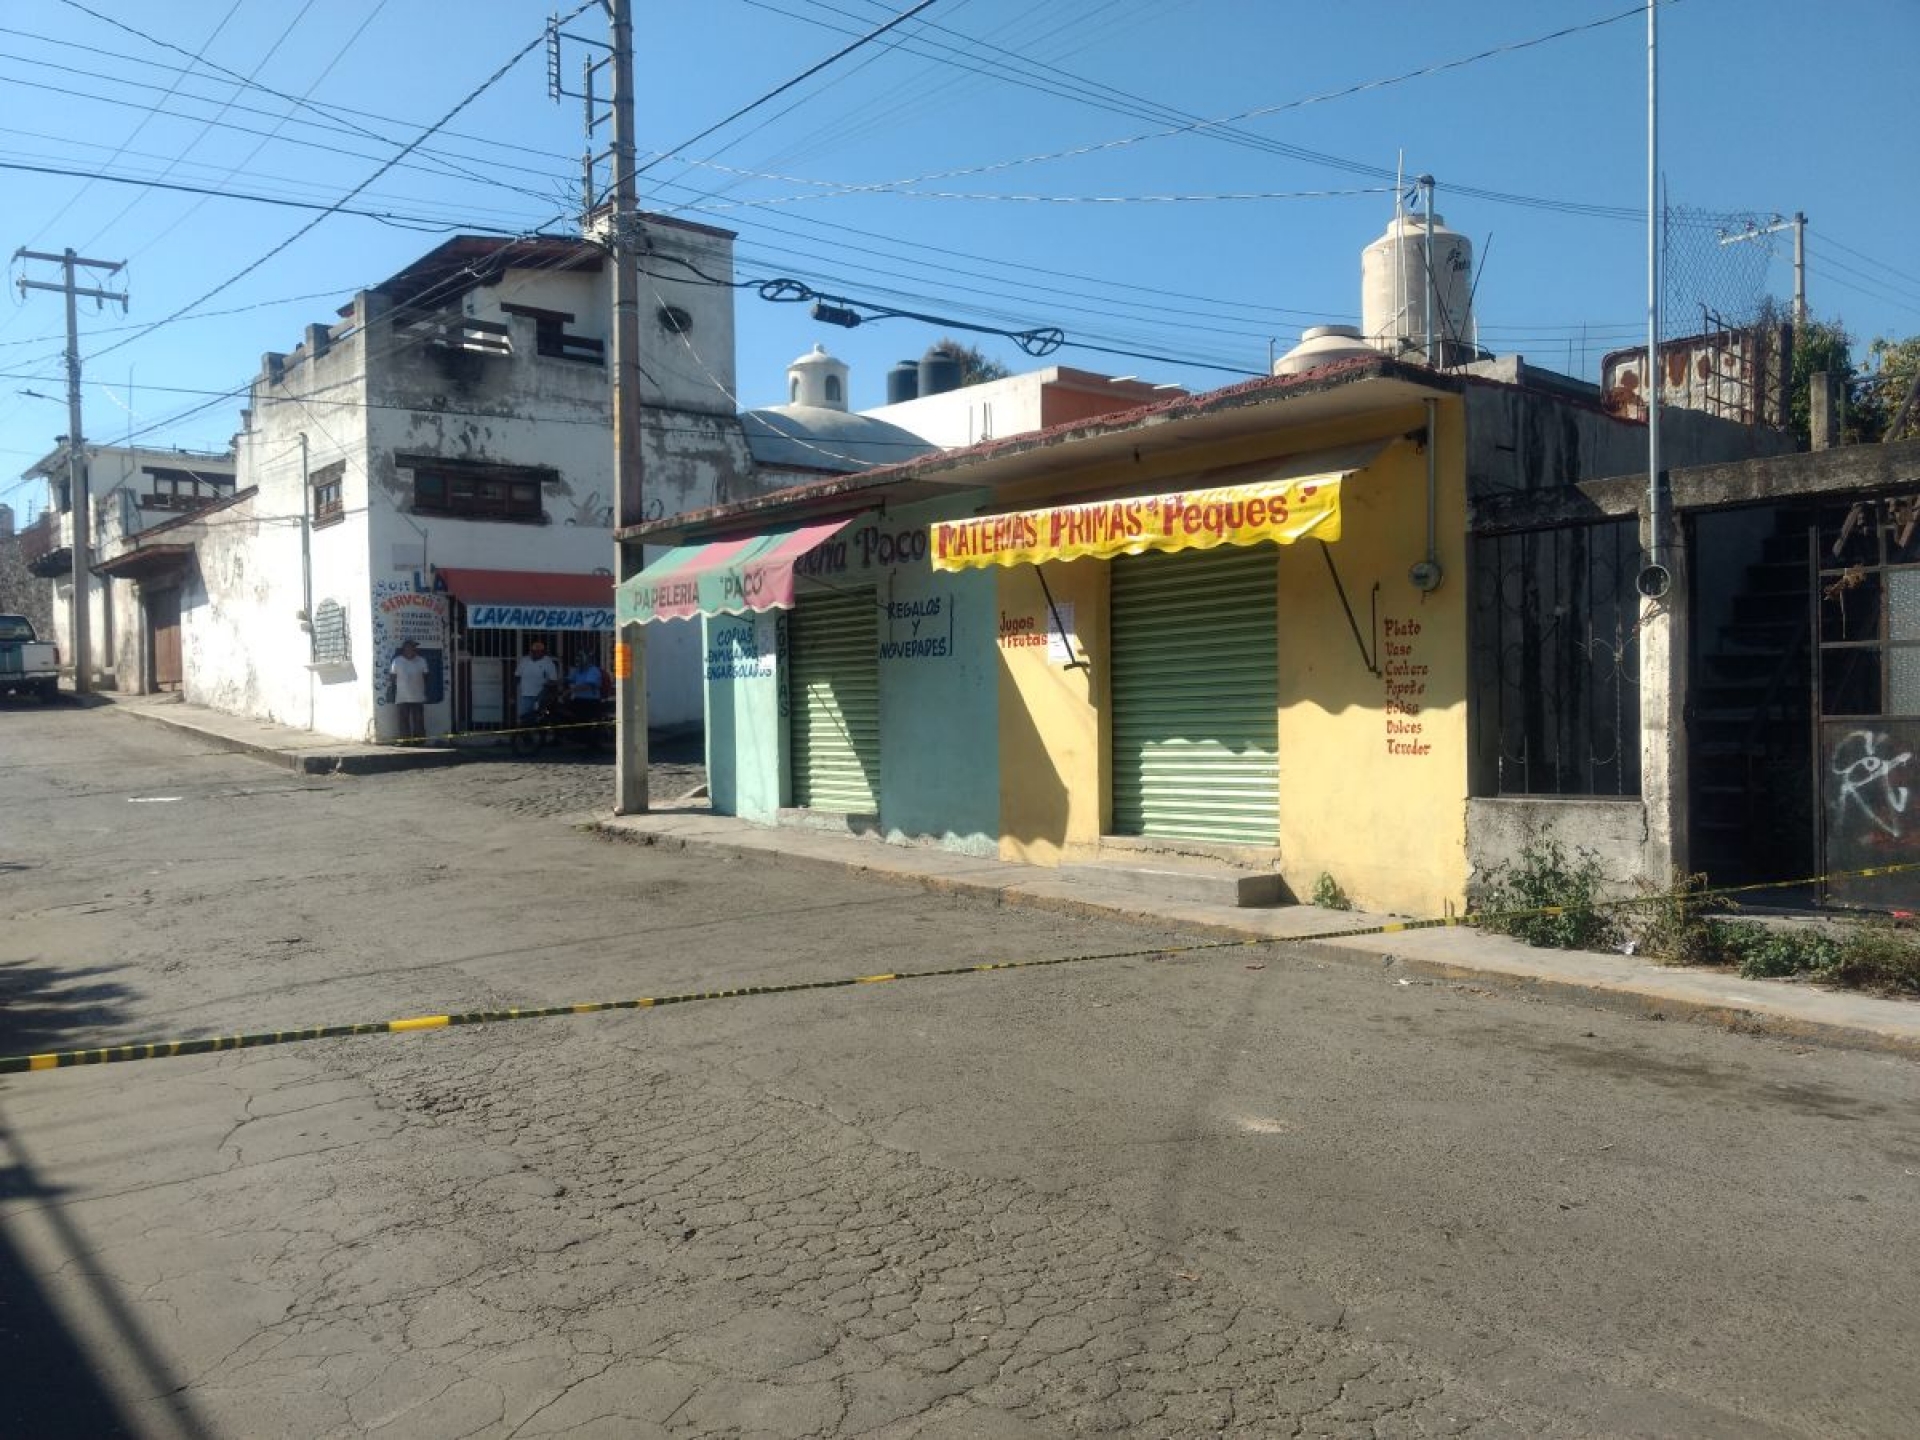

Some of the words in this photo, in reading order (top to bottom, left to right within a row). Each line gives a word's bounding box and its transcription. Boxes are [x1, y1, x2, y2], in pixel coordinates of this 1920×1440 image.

[938, 513, 1038, 559] MATERIAS
[1050, 502, 1142, 547] PRIMAS
[633, 580, 700, 611] PAPELERIA
[473, 606, 585, 628] LAVANDERIA
[887, 597, 941, 620] REGALOS
[911, 619, 921, 638] Y
[1384, 617, 1421, 637] Plato
[776, 614, 789, 718] COPIAS
